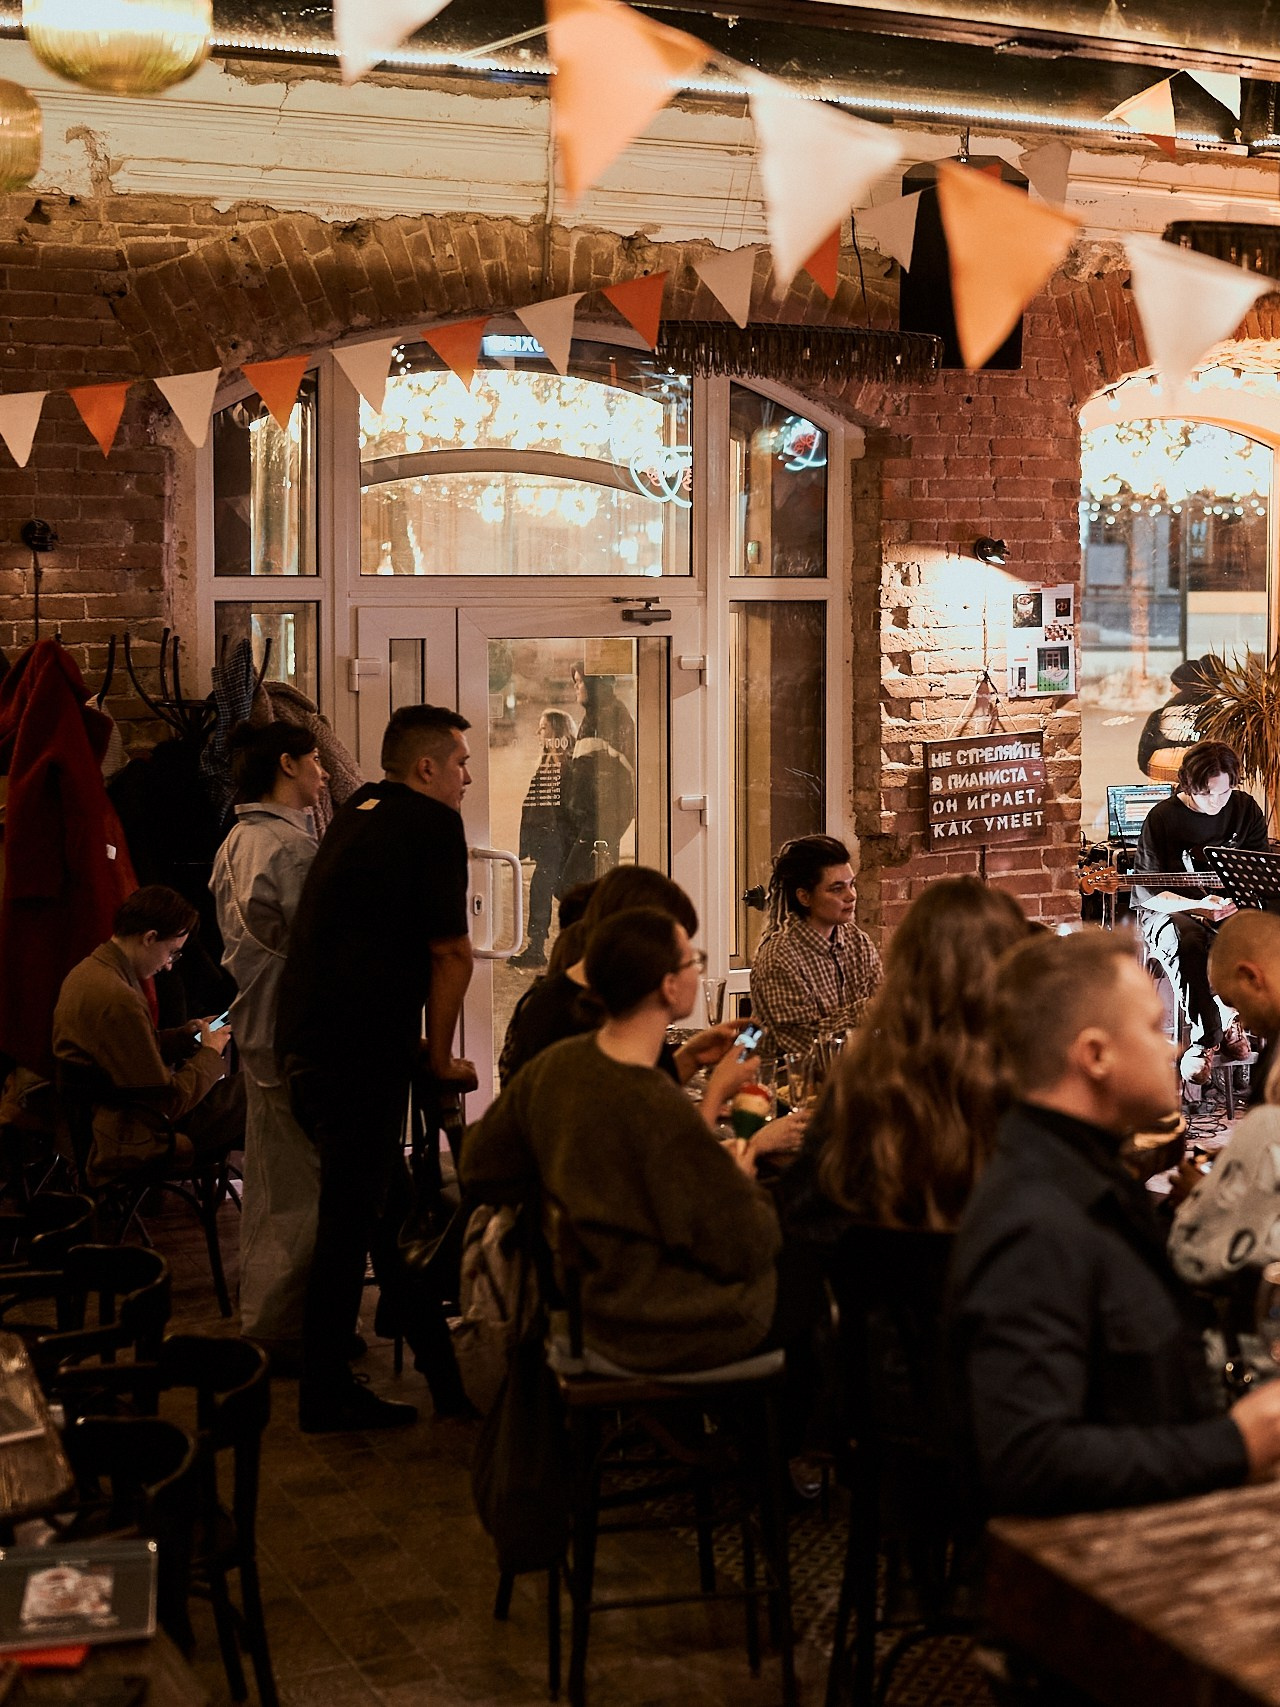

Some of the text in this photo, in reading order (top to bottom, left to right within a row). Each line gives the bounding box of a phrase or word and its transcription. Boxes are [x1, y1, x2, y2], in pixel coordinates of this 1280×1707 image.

[931, 740, 1041, 768] НЕ СТРЕЛЯЙТЕ
[931, 776, 943, 791] В
[947, 766, 1028, 790] ПИАНИСТА
[932, 788, 1042, 815] ОН ИГРАЕТ,
[932, 811, 1044, 838] КАК УМЕЕТ
